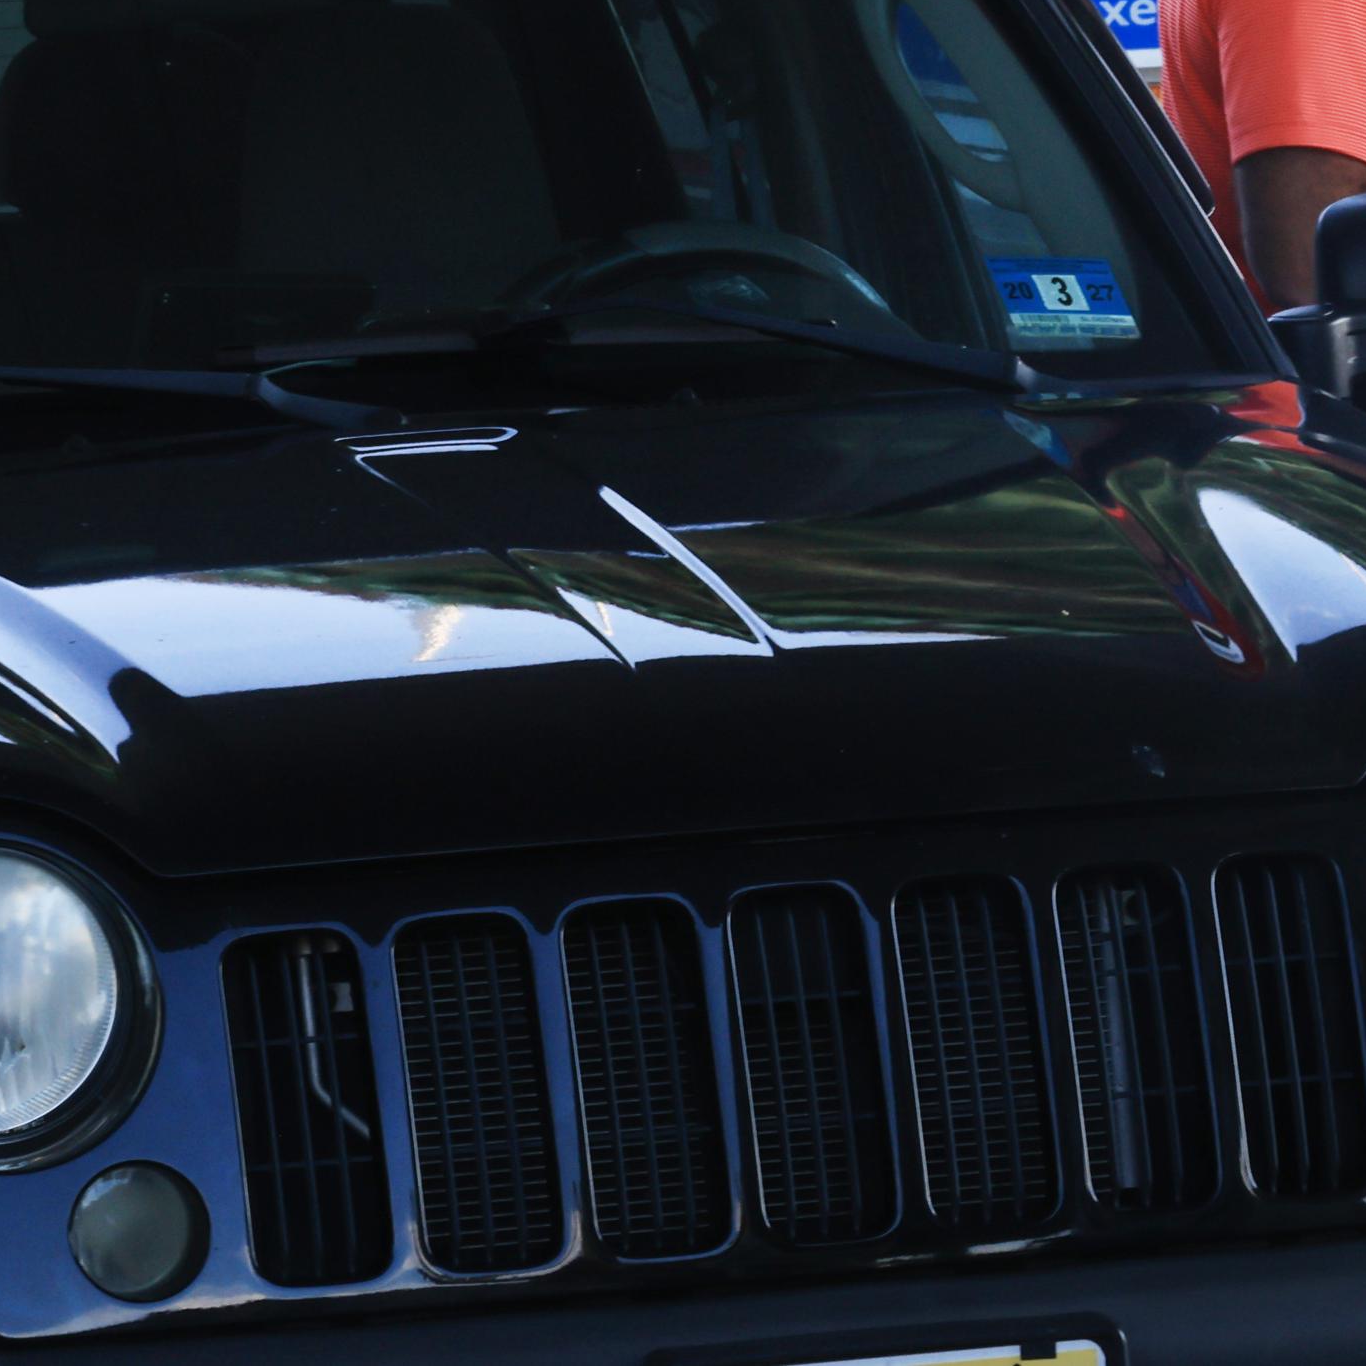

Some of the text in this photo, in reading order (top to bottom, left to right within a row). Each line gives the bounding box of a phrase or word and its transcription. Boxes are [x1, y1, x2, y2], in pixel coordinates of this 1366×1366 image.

[1004, 276, 1115, 307] 20 3 27
